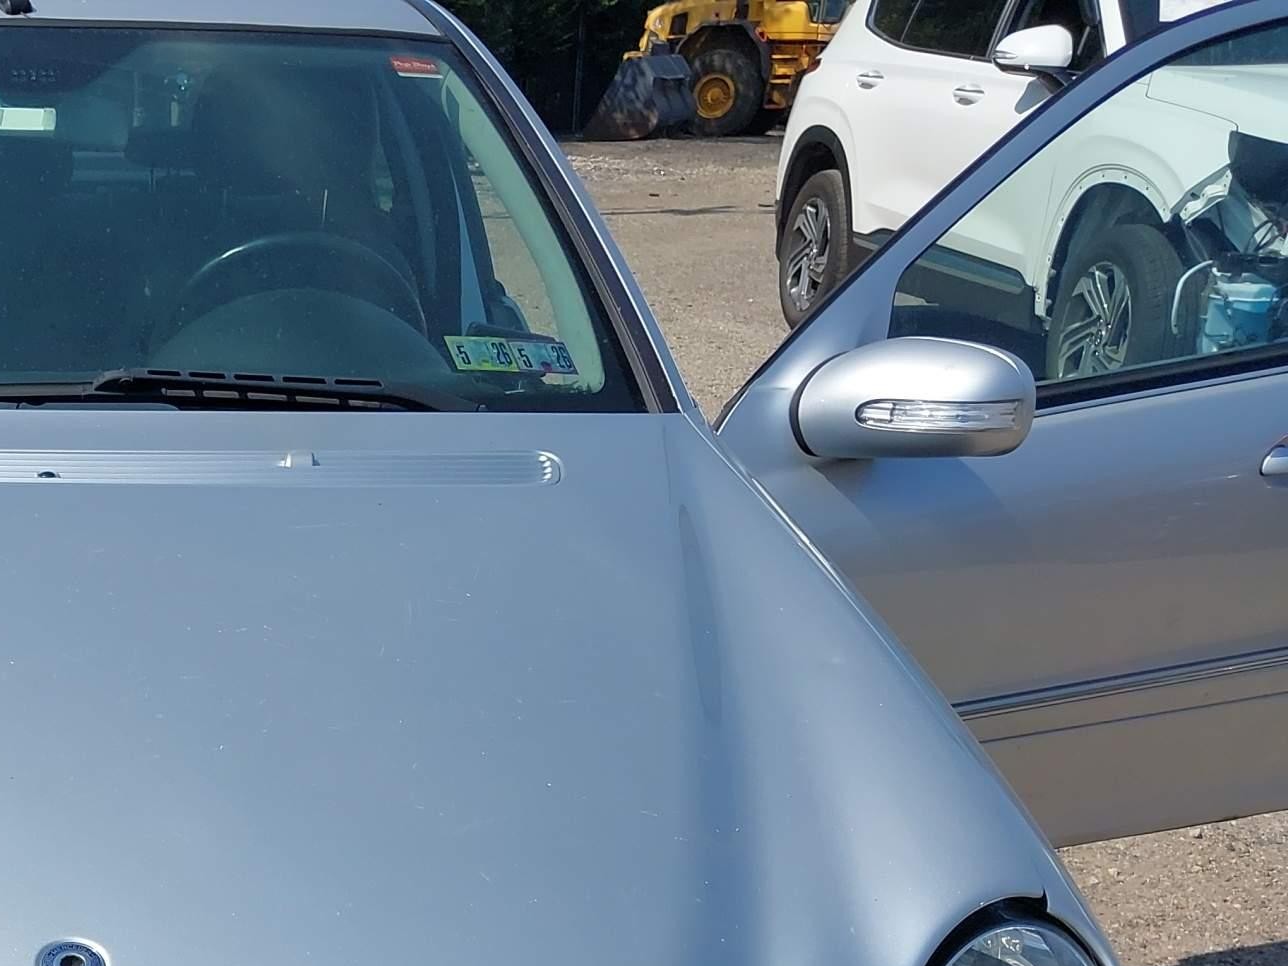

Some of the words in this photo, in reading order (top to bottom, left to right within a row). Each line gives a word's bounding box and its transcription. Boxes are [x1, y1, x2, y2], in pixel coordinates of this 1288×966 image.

[456, 345, 471, 365] 5
[491, 342, 513, 366] 26
[517, 347, 533, 369] 5
[551, 346, 573, 369] 26
